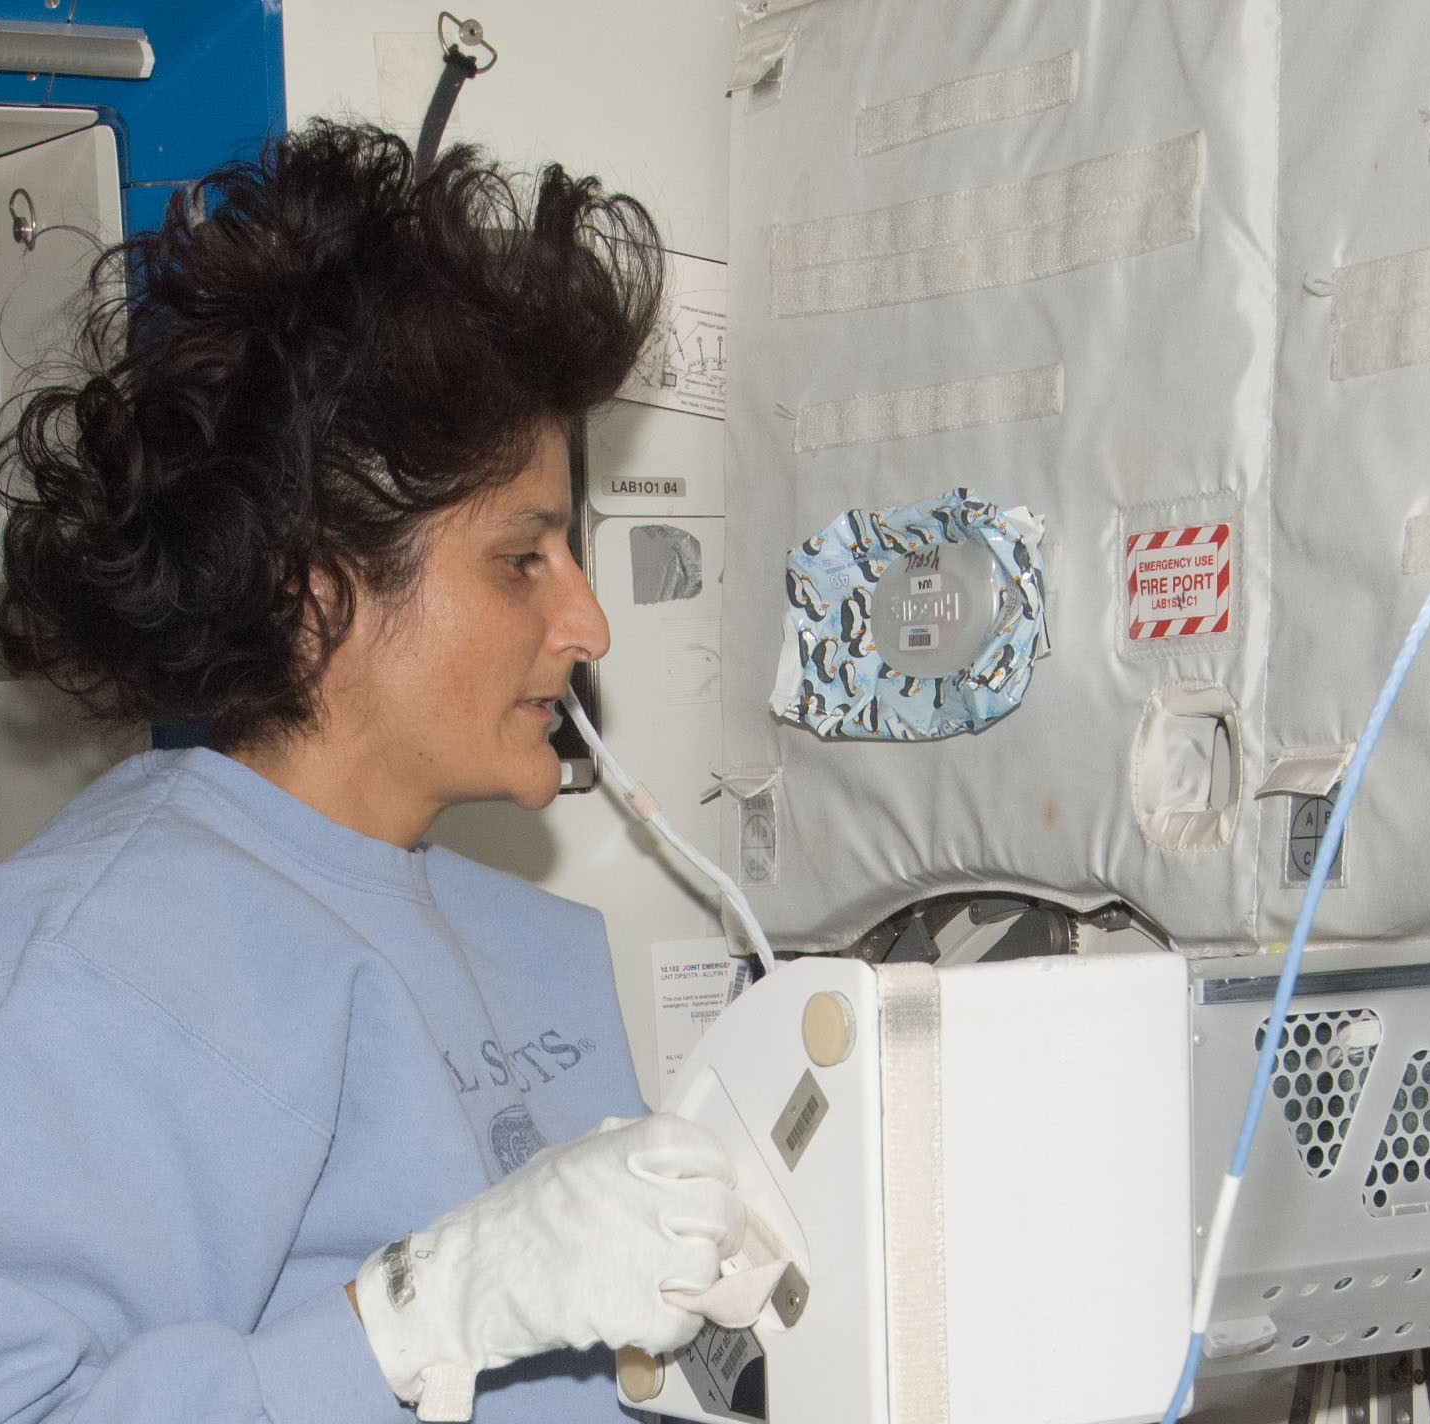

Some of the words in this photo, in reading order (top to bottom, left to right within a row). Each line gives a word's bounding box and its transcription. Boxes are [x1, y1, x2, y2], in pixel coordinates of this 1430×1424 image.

[1138, 558, 1192, 573] EMERGENCY
[1194, 555, 1214, 567] USE
[1140, 577, 1168, 596] FIRE
[1172, 573, 1214, 593] PORT
[1305, 812, 1313, 826] A
[1303, 851, 1312, 865] C
[683, 963, 700, 971] JOINT
[685, 1348, 696, 1362] 2
[707, 1390, 717, 1402] 1
